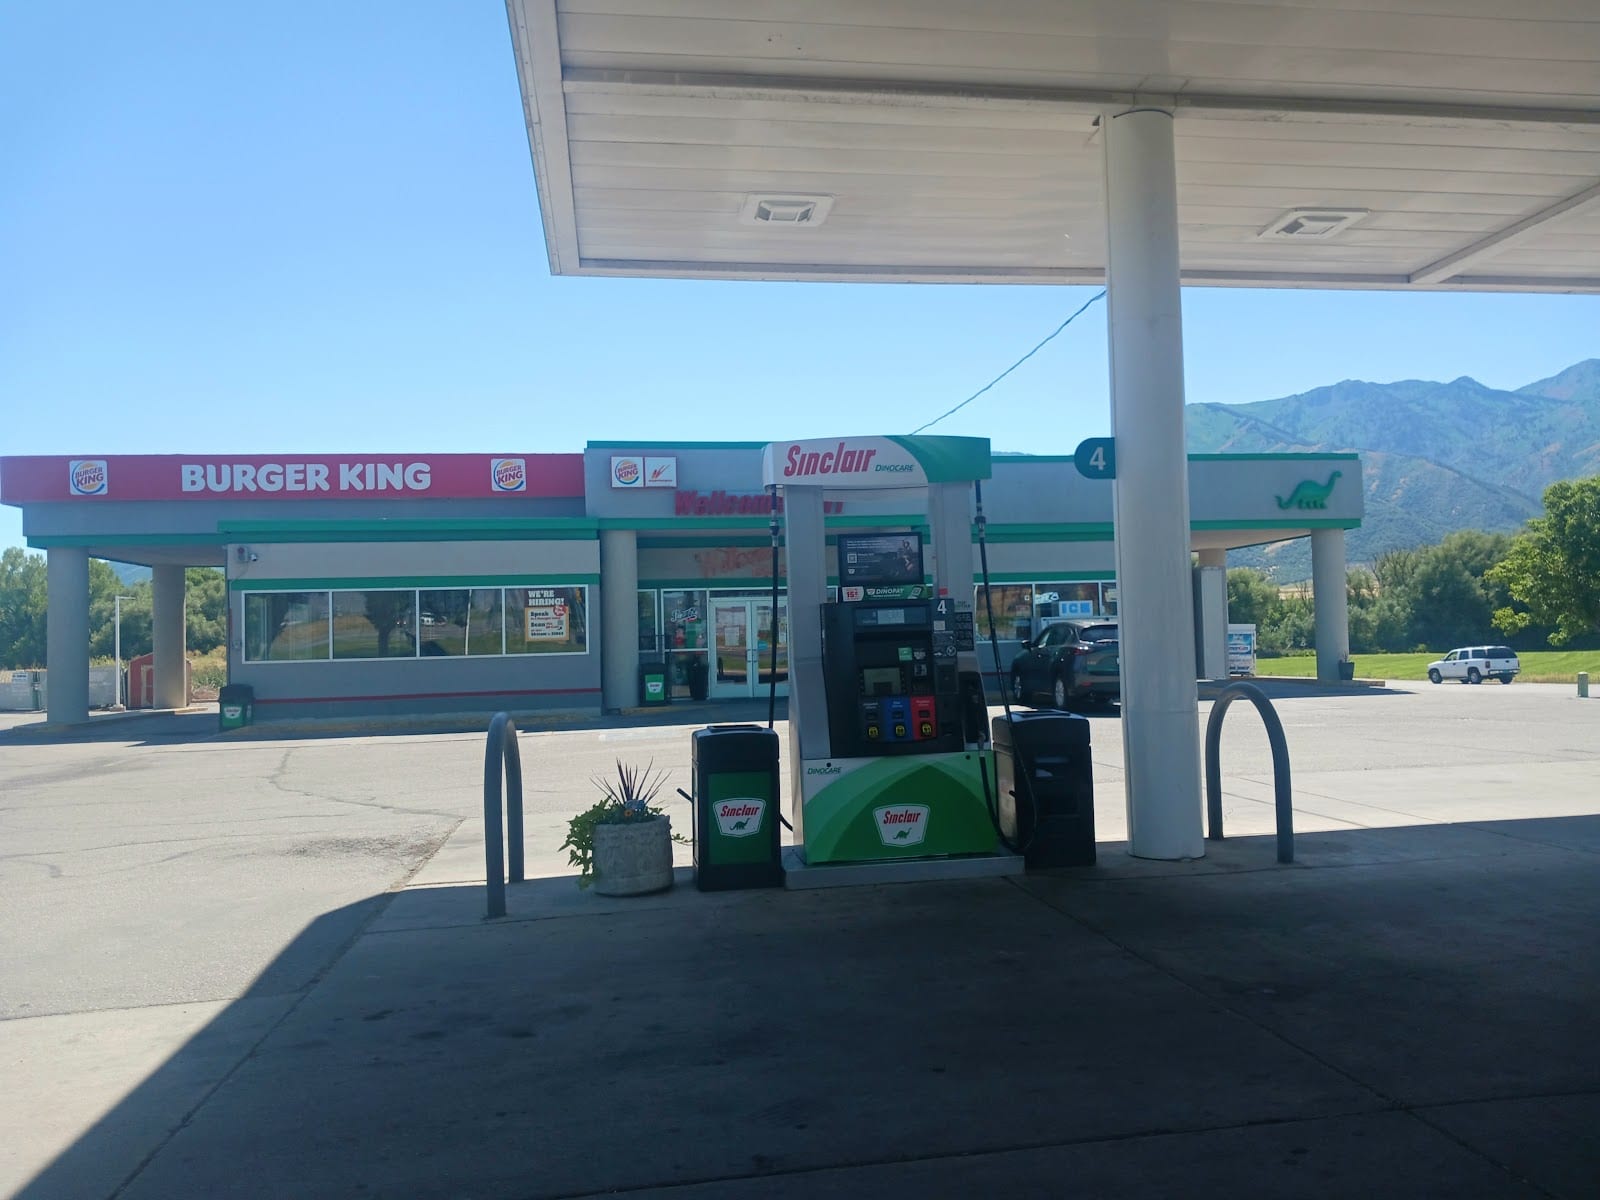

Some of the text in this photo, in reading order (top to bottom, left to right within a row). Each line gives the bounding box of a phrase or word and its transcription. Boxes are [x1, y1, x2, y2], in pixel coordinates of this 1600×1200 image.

[784, 442, 877, 477] Sinclair
[1089, 446, 1107, 470] 4
[618, 468, 639, 480] KING
[874, 464, 915, 472] DINOCARE
[76, 473, 104, 488] KING
[181, 462, 432, 492] BURGER KING
[497, 470, 523, 485] KING
[527, 590, 555, 598] WE'RE
[528, 597, 565, 606] HIRING!
[937, 599, 948, 614] 4
[807, 766, 842, 775] DINOCARE
[720, 804, 760, 818] Sinclair
[883, 809, 921, 825] Sinclair
